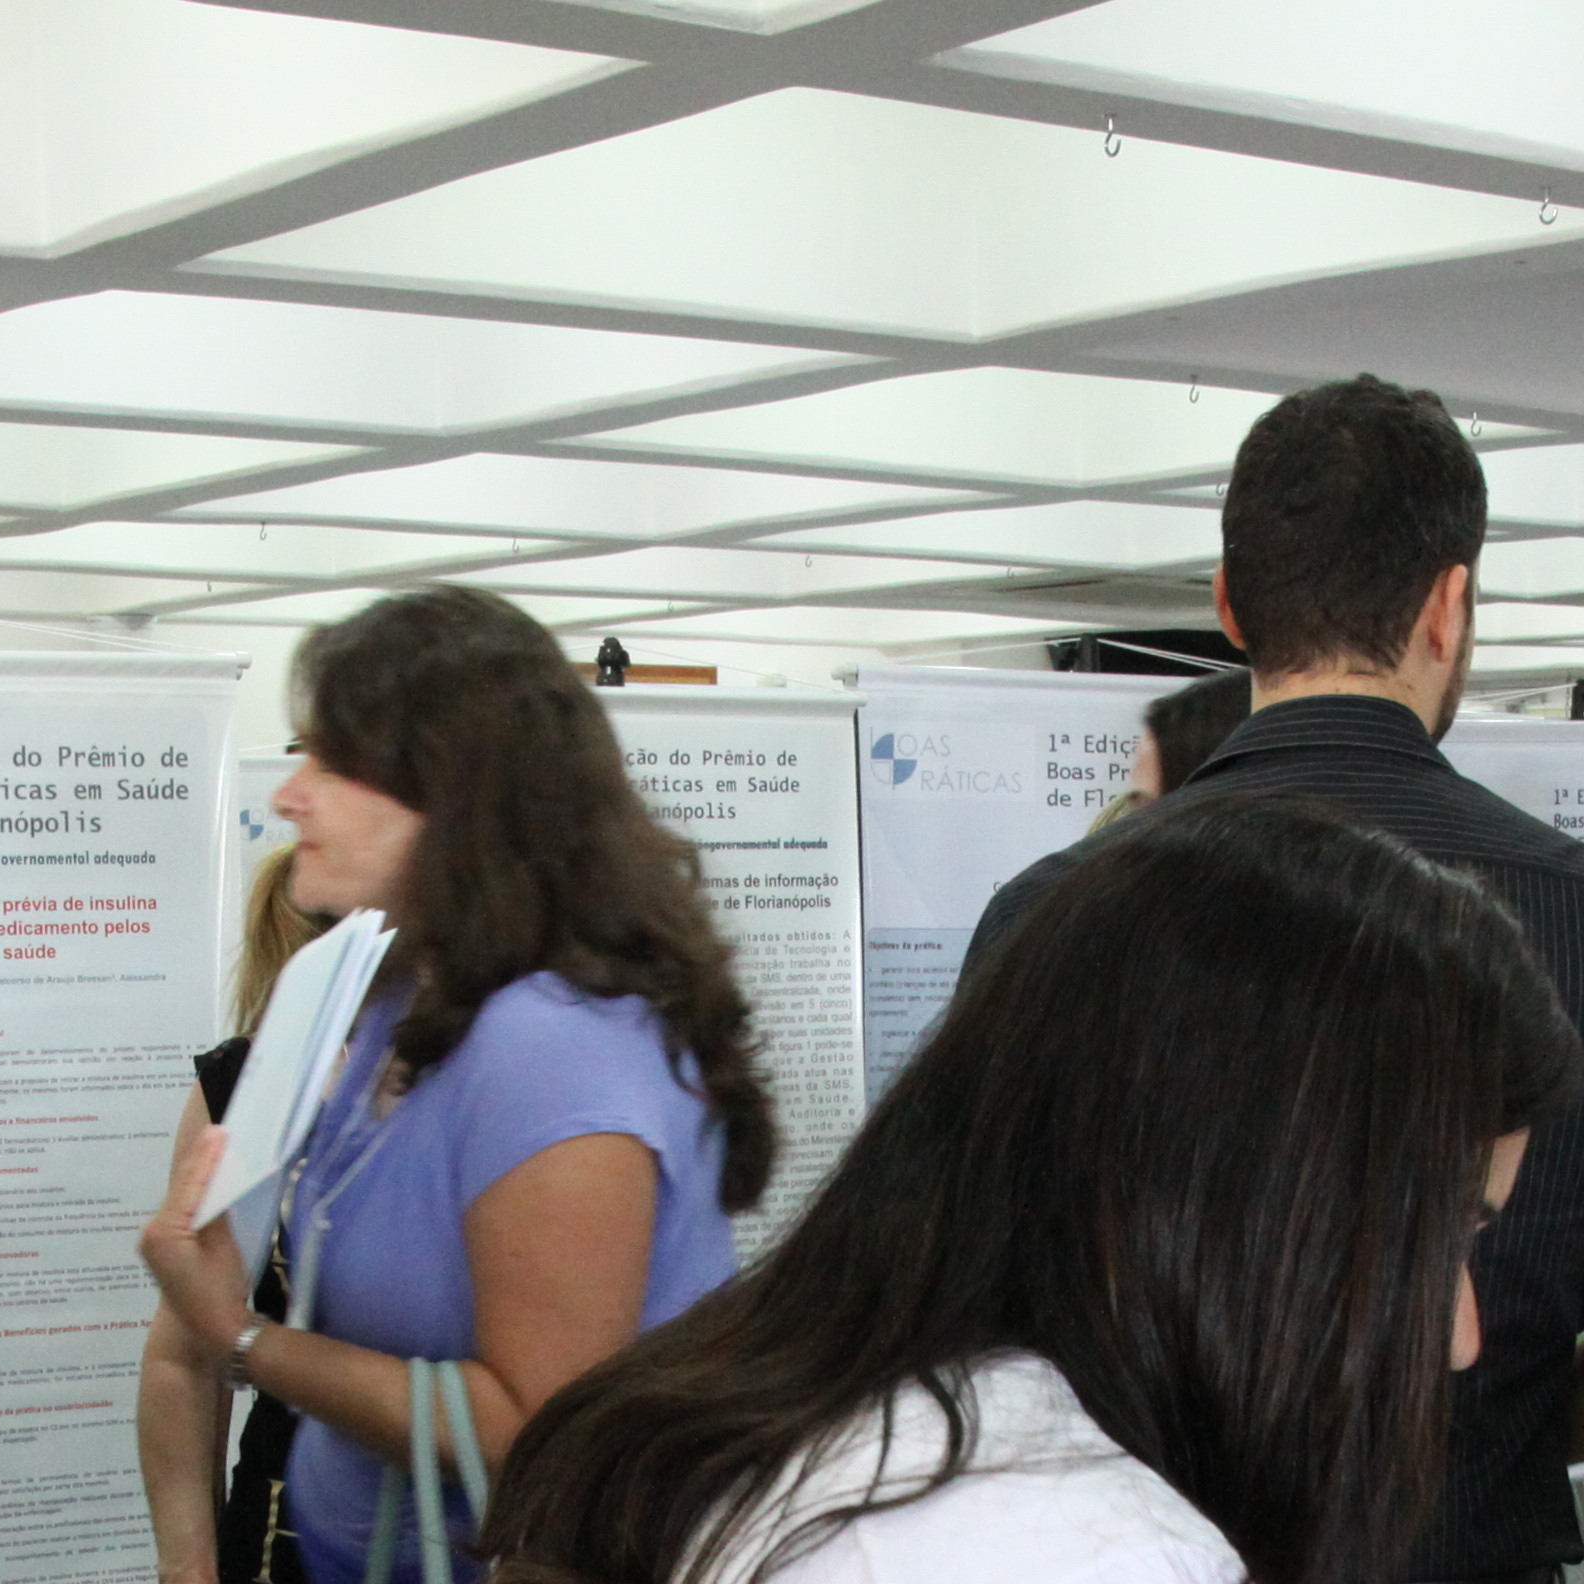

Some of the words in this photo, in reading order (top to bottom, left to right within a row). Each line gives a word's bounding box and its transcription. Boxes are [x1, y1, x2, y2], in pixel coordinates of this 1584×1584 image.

[1048, 733, 1070, 751] 1ª
[12, 745, 43, 769] do
[58, 744, 145, 769] Prêmio
[161, 745, 190, 769] de
[625, 750, 658, 768] ção
[669, 749, 691, 766] do
[702, 749, 766, 766] Prêmio
[777, 750, 798, 767] de
[1047, 762, 1095, 781] Boas
[74, 783, 103, 801] em
[117, 776, 190, 801] Saúde
[632, 775, 704, 793] áticas
[716, 780, 737, 793] em
[747, 776, 800, 793] Saúde
[1047, 789, 1072, 807] de
[1553, 789, 1568, 805] 1ª
[652, 802, 737, 823] anópolis
[1553, 812, 1584, 829] Boas
[93, 851, 156, 867] adequada
[744, 874, 761, 888] de
[765, 873, 839, 889] informação
[3, 896, 57, 916] prévia
[63, 895, 84, 911] de
[89, 895, 158, 911] insulina
[724, 895, 740, 911] de
[745, 894, 832, 912] Florianópolis
[104, 919, 151, 938] pelos
[842, 929, 852, 940] A
[4, 943, 57, 960] saúde
